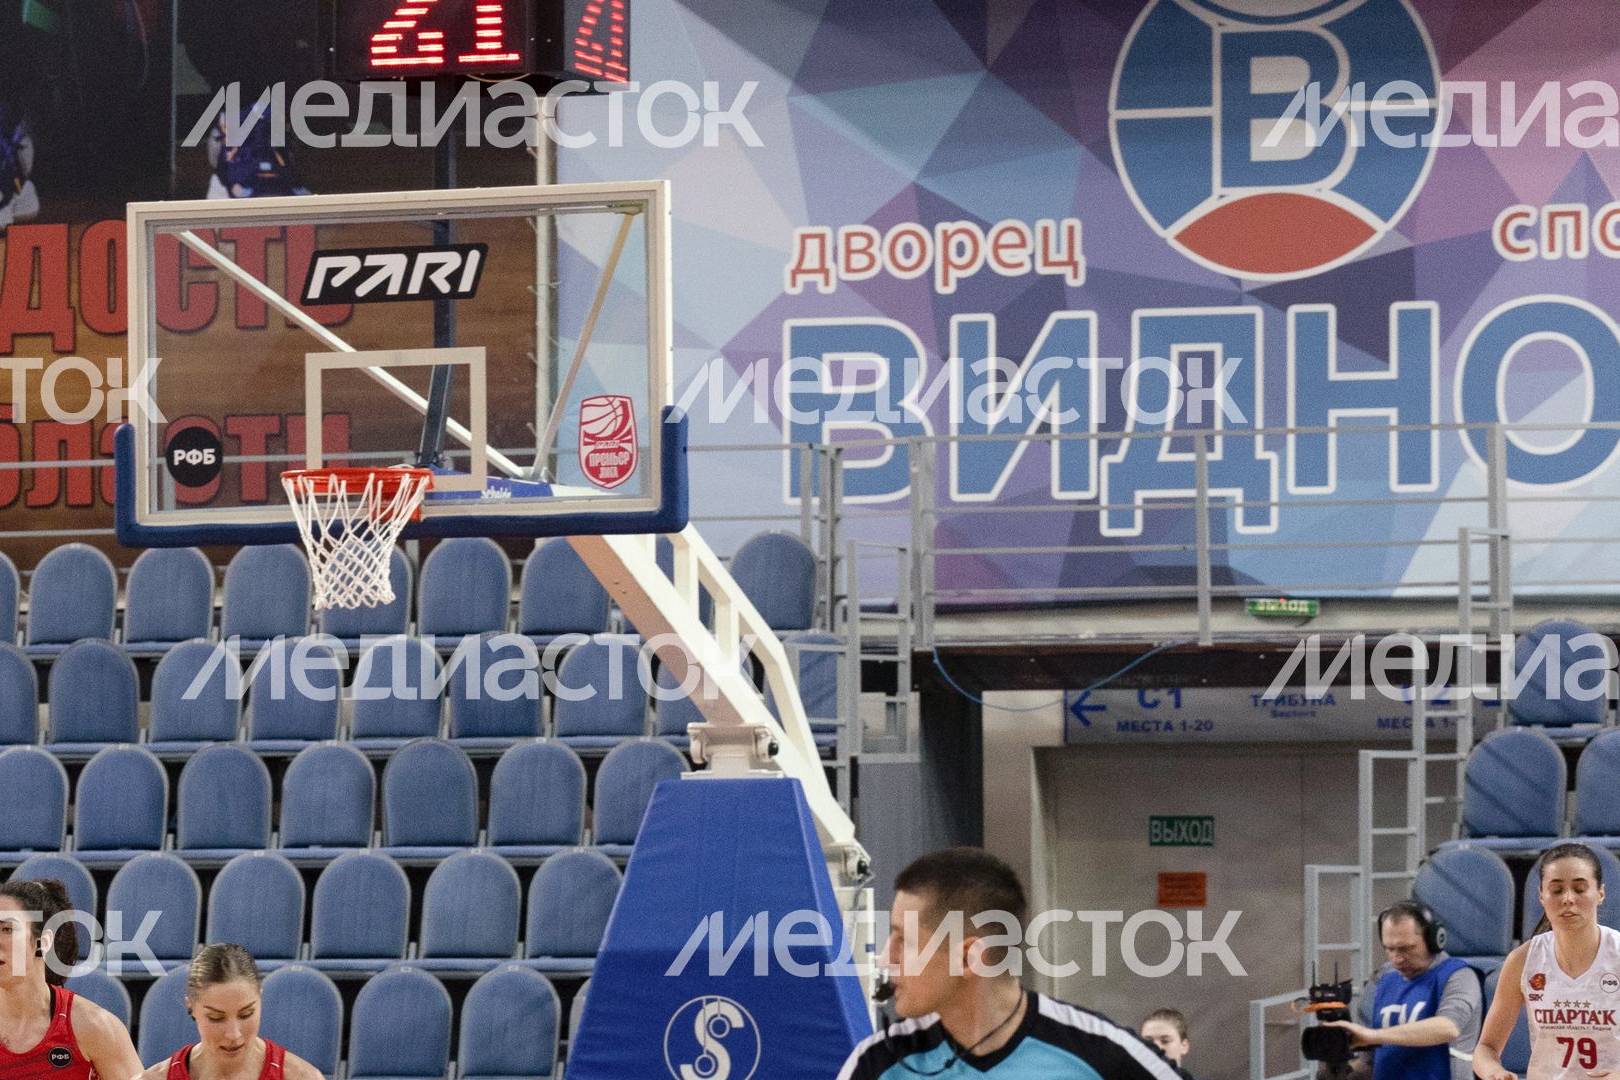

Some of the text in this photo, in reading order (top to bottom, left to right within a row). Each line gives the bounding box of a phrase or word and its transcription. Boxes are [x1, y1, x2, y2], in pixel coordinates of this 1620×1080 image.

[788, 221, 1085, 291] дворец
[306, 249, 481, 299] PARI
[783, 294, 1620, 538] ВИДНО
[173, 448, 216, 466] РФБ
[1116, 720, 1214, 732] МЕСТА 1-20
[1377, 717, 1434, 729] МЕСА
[1151, 820, 1213, 842] ВЫХОД
[1534, 1009, 1617, 1026] СПАРТАК
[1556, 1036, 1598, 1070] 79
